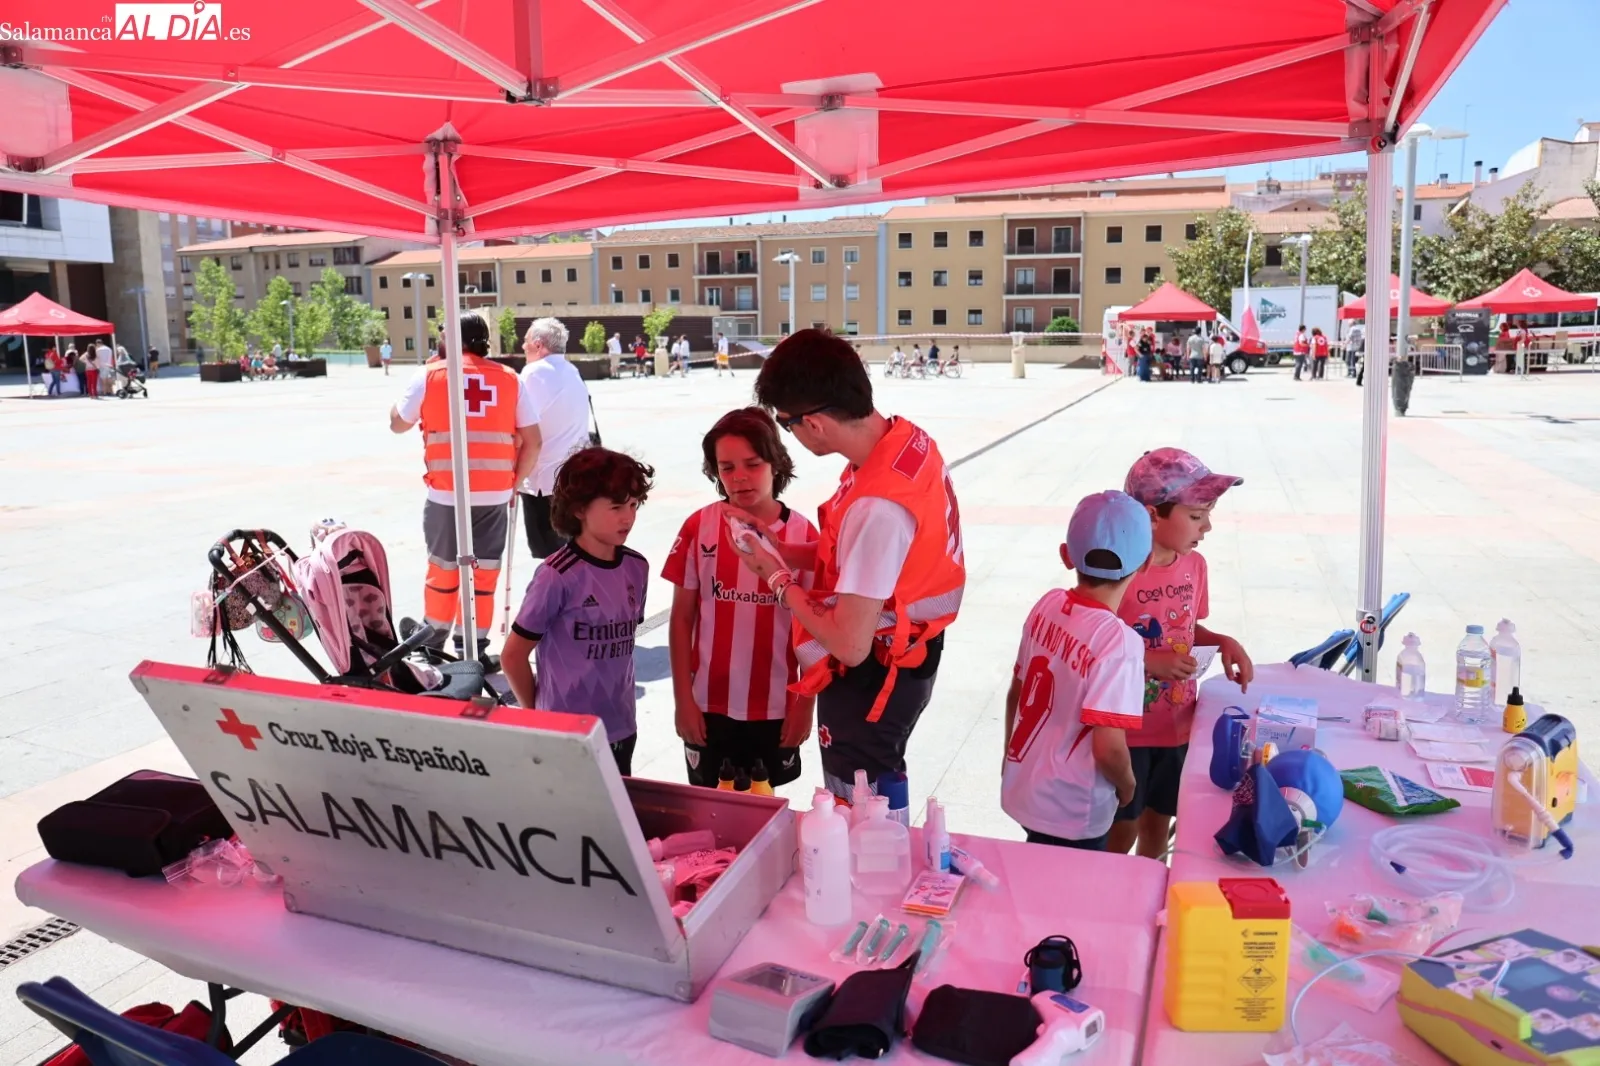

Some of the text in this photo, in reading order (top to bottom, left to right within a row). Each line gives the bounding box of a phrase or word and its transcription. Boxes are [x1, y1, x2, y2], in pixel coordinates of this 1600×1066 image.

[1137, 586, 1164, 604] Cool
[587, 638, 634, 660] FLY BETTE
[1006, 655, 1054, 764] 9
[267, 721, 491, 778] Cruz Roja Española
[210, 770, 638, 897] SALAMANCA
